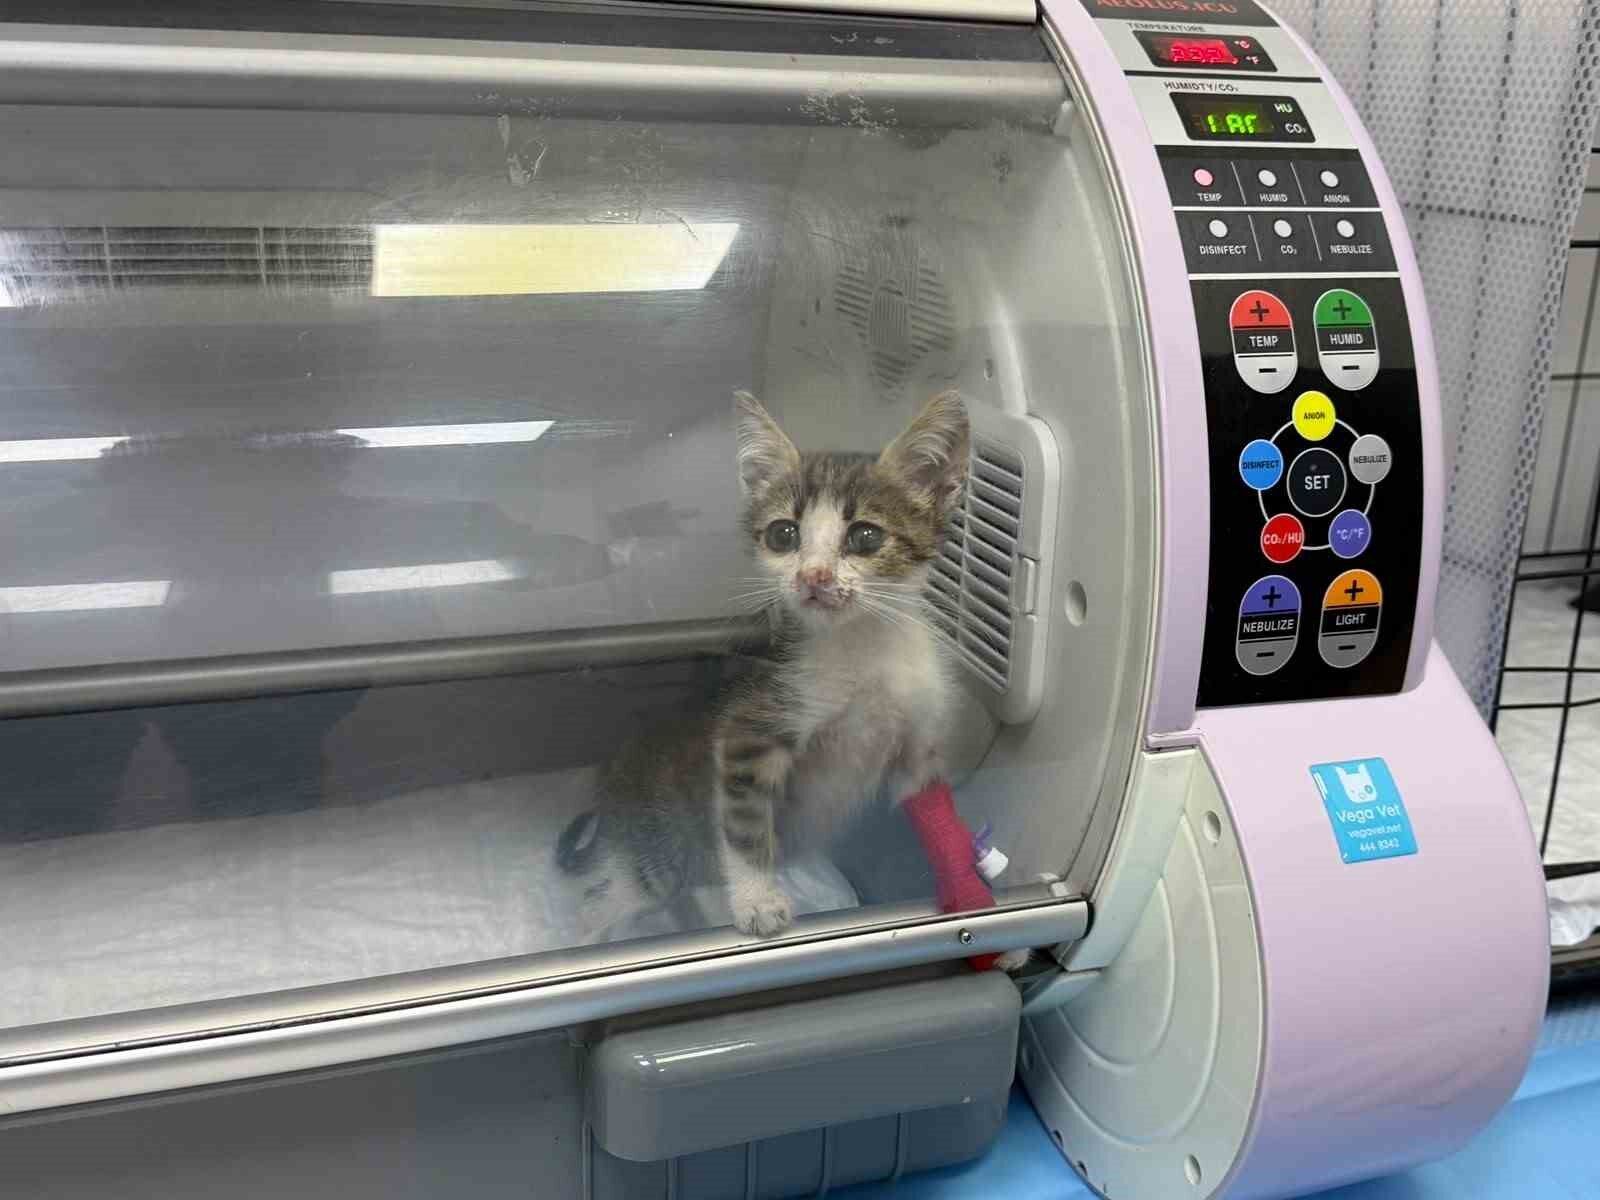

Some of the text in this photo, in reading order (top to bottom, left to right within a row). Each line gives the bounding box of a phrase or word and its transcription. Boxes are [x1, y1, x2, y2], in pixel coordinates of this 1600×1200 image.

[1127, 22, 1206, 33] TEMPERATURE
[1274, 102, 1294, 113] HU
[1197, 192, 1223, 202] TEMP
[1259, 193, 1288, 203] HUMID
[1323, 194, 1350, 204] ANION
[1199, 245, 1247, 256] DISINFECT
[1330, 244, 1374, 255] NEBULIZE
[1249, 335, 1279, 348] TEMP
[1329, 332, 1364, 345] HUMID
[1303, 410, 1326, 420] ANION
[1242, 459, 1280, 469] DISINFECT
[1353, 454, 1388, 464] NEBULIZE
[1304, 474, 1331, 491] SET
[1335, 613, 1368, 626] LIGHT
[1243, 618, 1295, 633] NEBULIZE
[1336, 804, 1401, 823] Vega Vet
